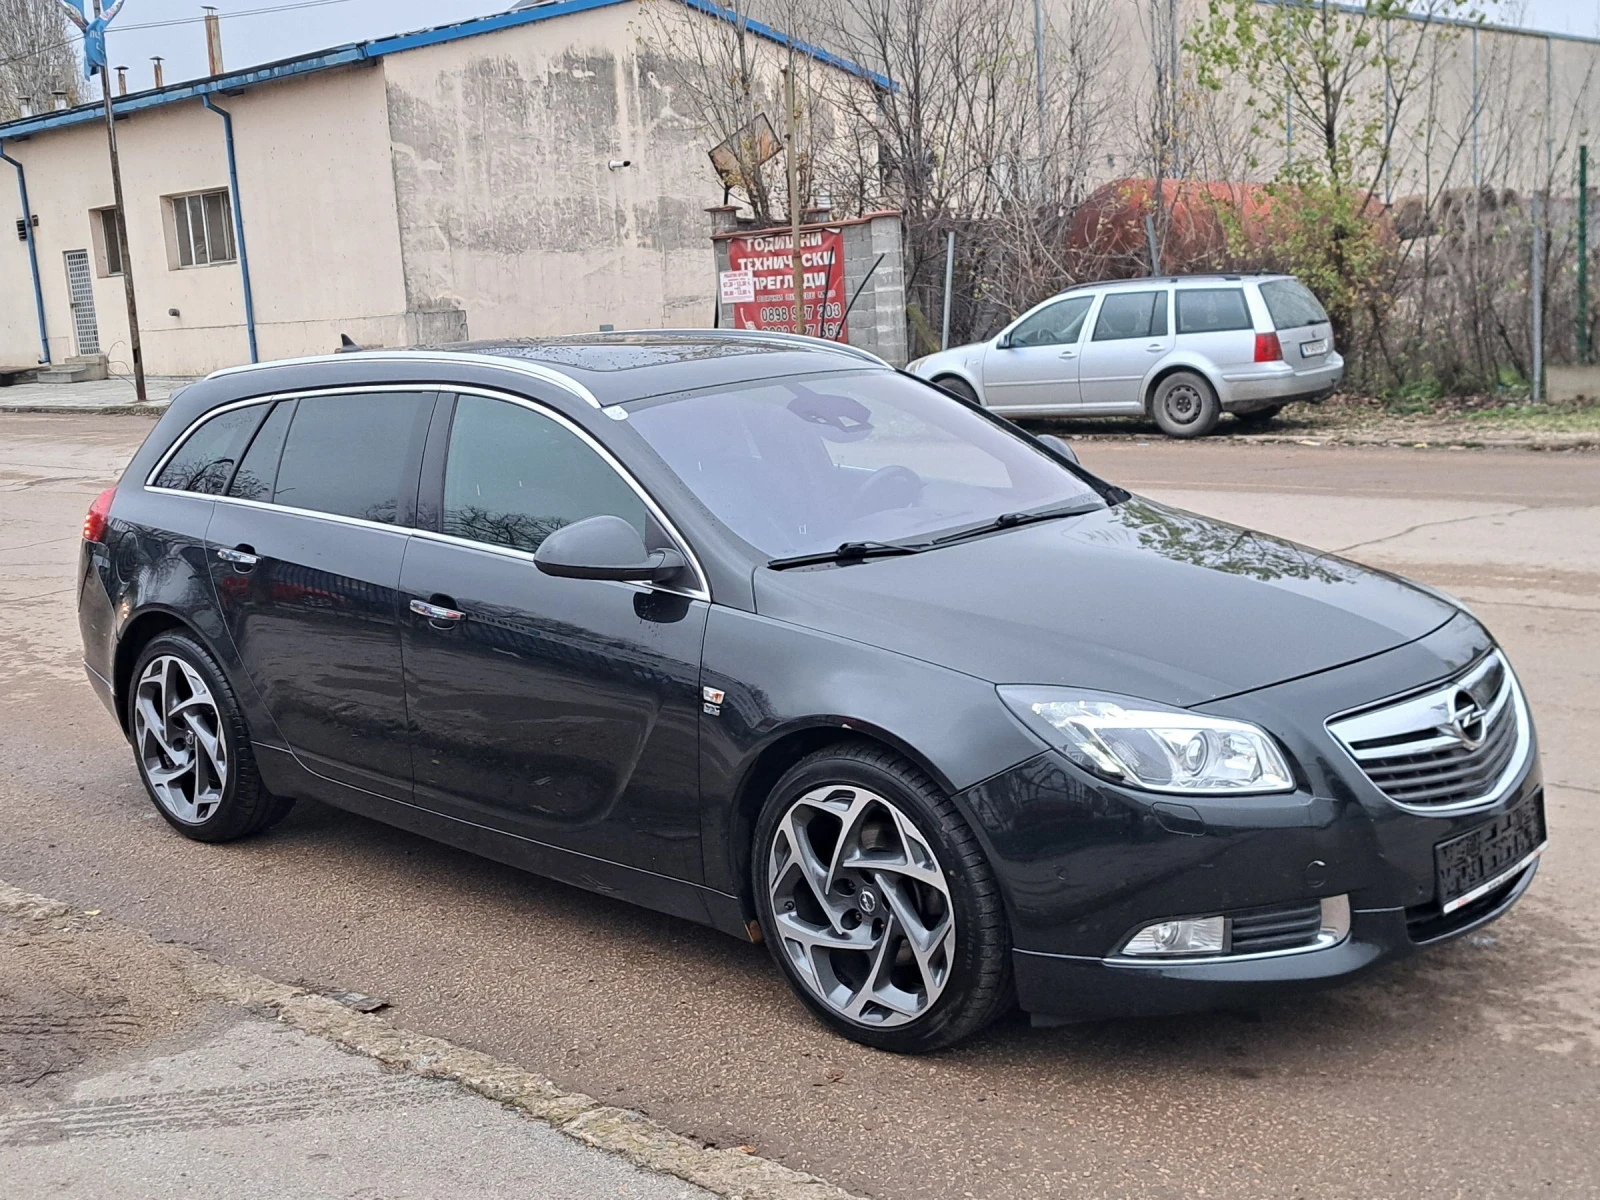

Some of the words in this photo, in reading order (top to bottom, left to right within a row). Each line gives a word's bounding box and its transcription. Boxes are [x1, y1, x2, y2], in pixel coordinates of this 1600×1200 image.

[738, 250, 836, 271] ТЕХНИЧСКИ
[753, 272, 826, 290] ПРЕГЛДИ
[761, 305, 789, 322] 0898
